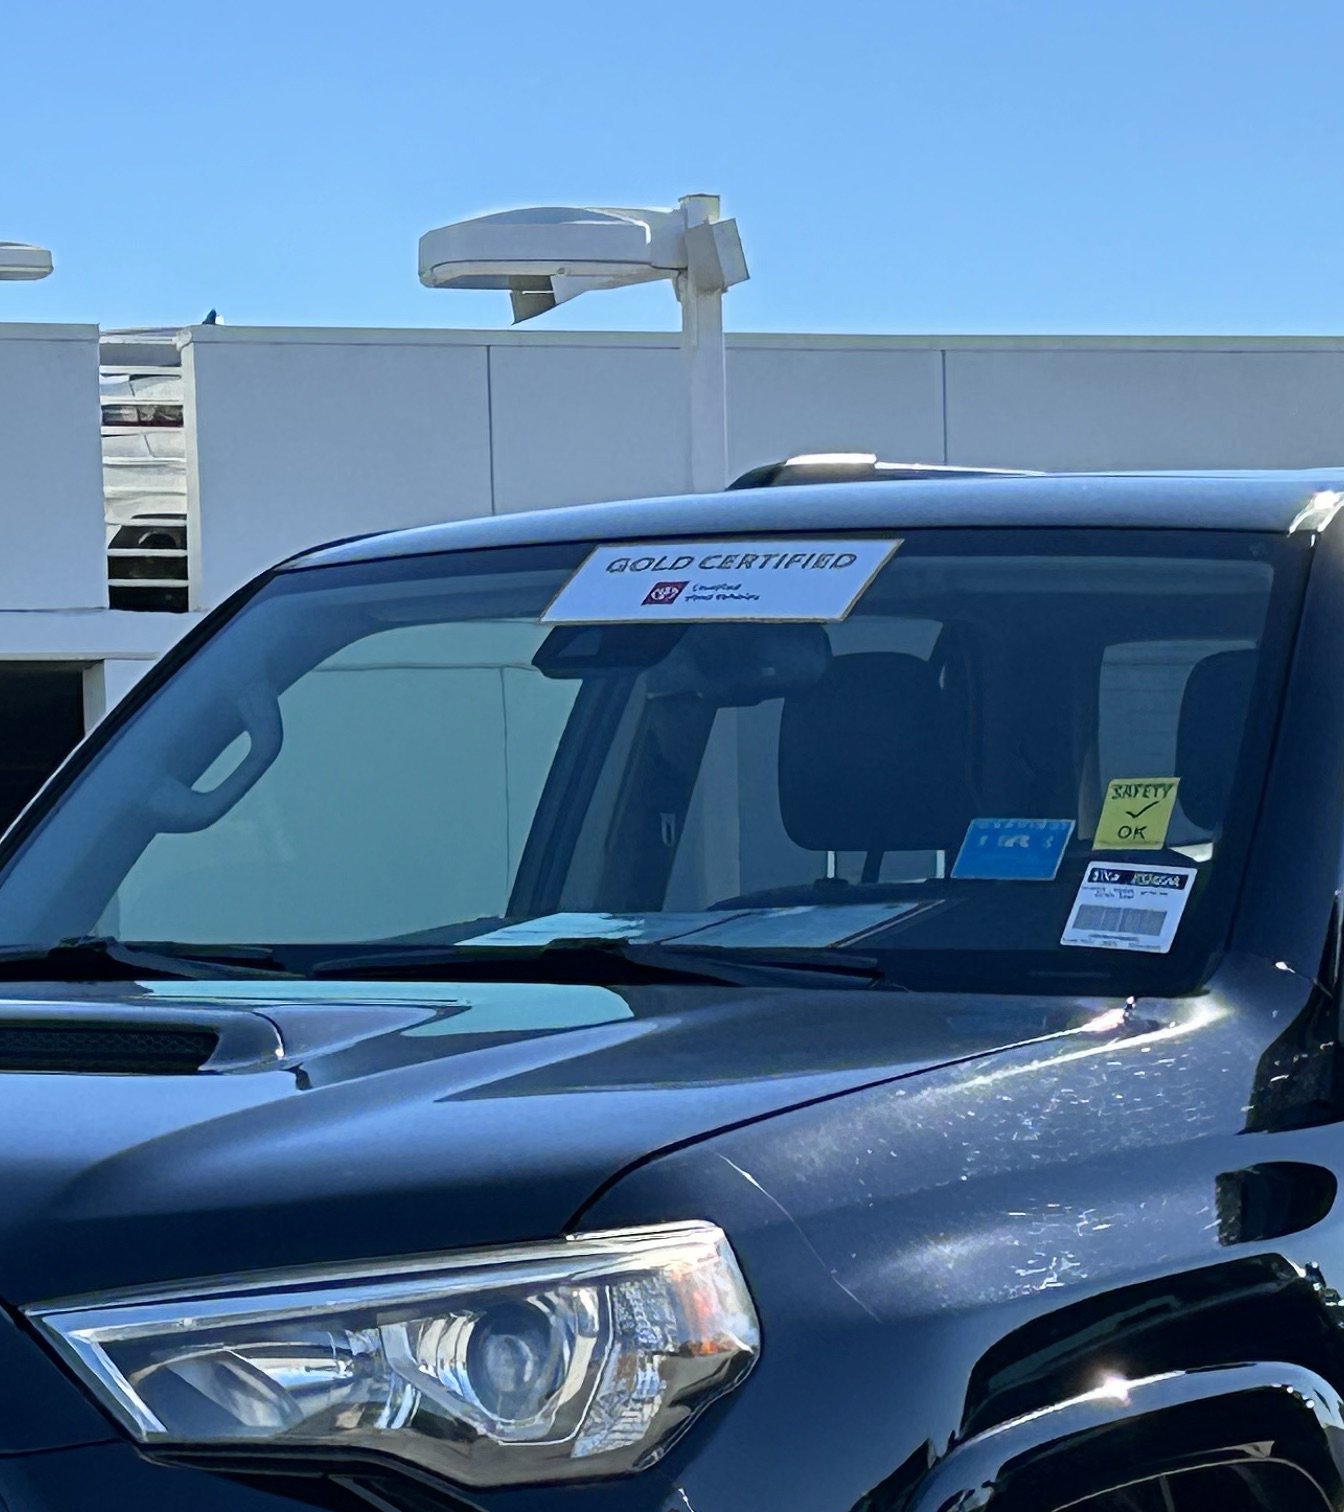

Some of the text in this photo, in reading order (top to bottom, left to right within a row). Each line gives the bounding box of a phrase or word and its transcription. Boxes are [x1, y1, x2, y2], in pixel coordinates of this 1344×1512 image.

[605, 551, 857, 574] GOLD CERTIFIED
[1110, 782, 1174, 800] SAFETY
[1117, 824, 1147, 840] OK
